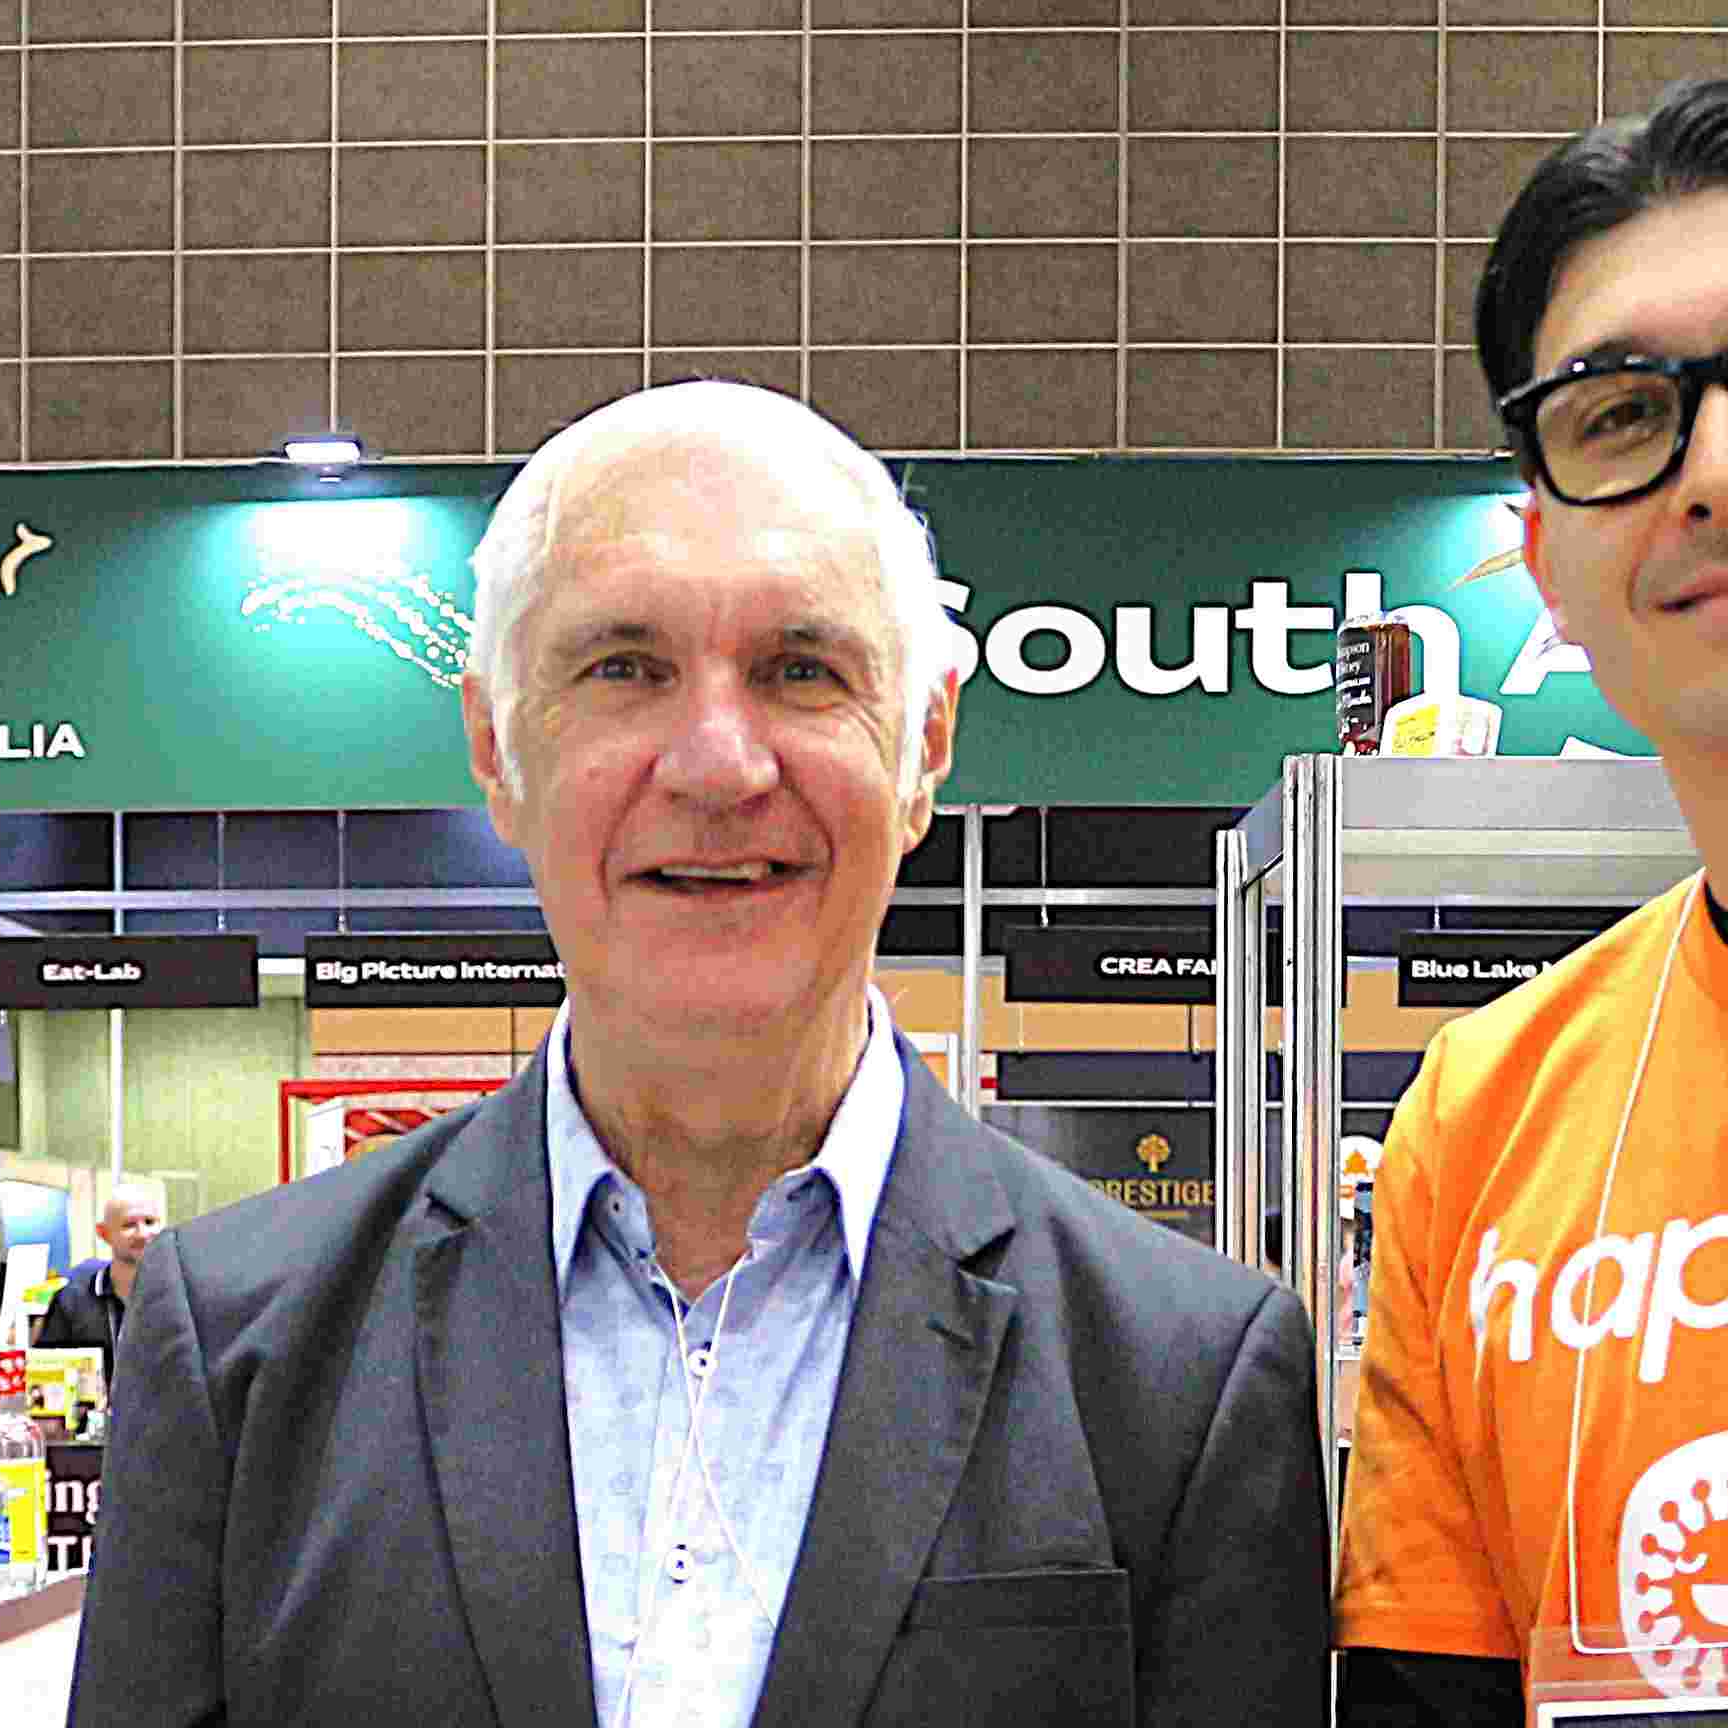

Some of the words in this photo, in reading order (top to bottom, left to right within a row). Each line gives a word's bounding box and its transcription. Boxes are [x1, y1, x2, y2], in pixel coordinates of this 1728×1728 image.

[42, 961, 141, 982] Eat-Lab
[316, 961, 358, 984] Big
[362, 961, 457, 979] Picture
[1101, 957, 1173, 975] CREA
[1412, 960, 1469, 978] Blue
[1473, 960, 1537, 978] Lake
